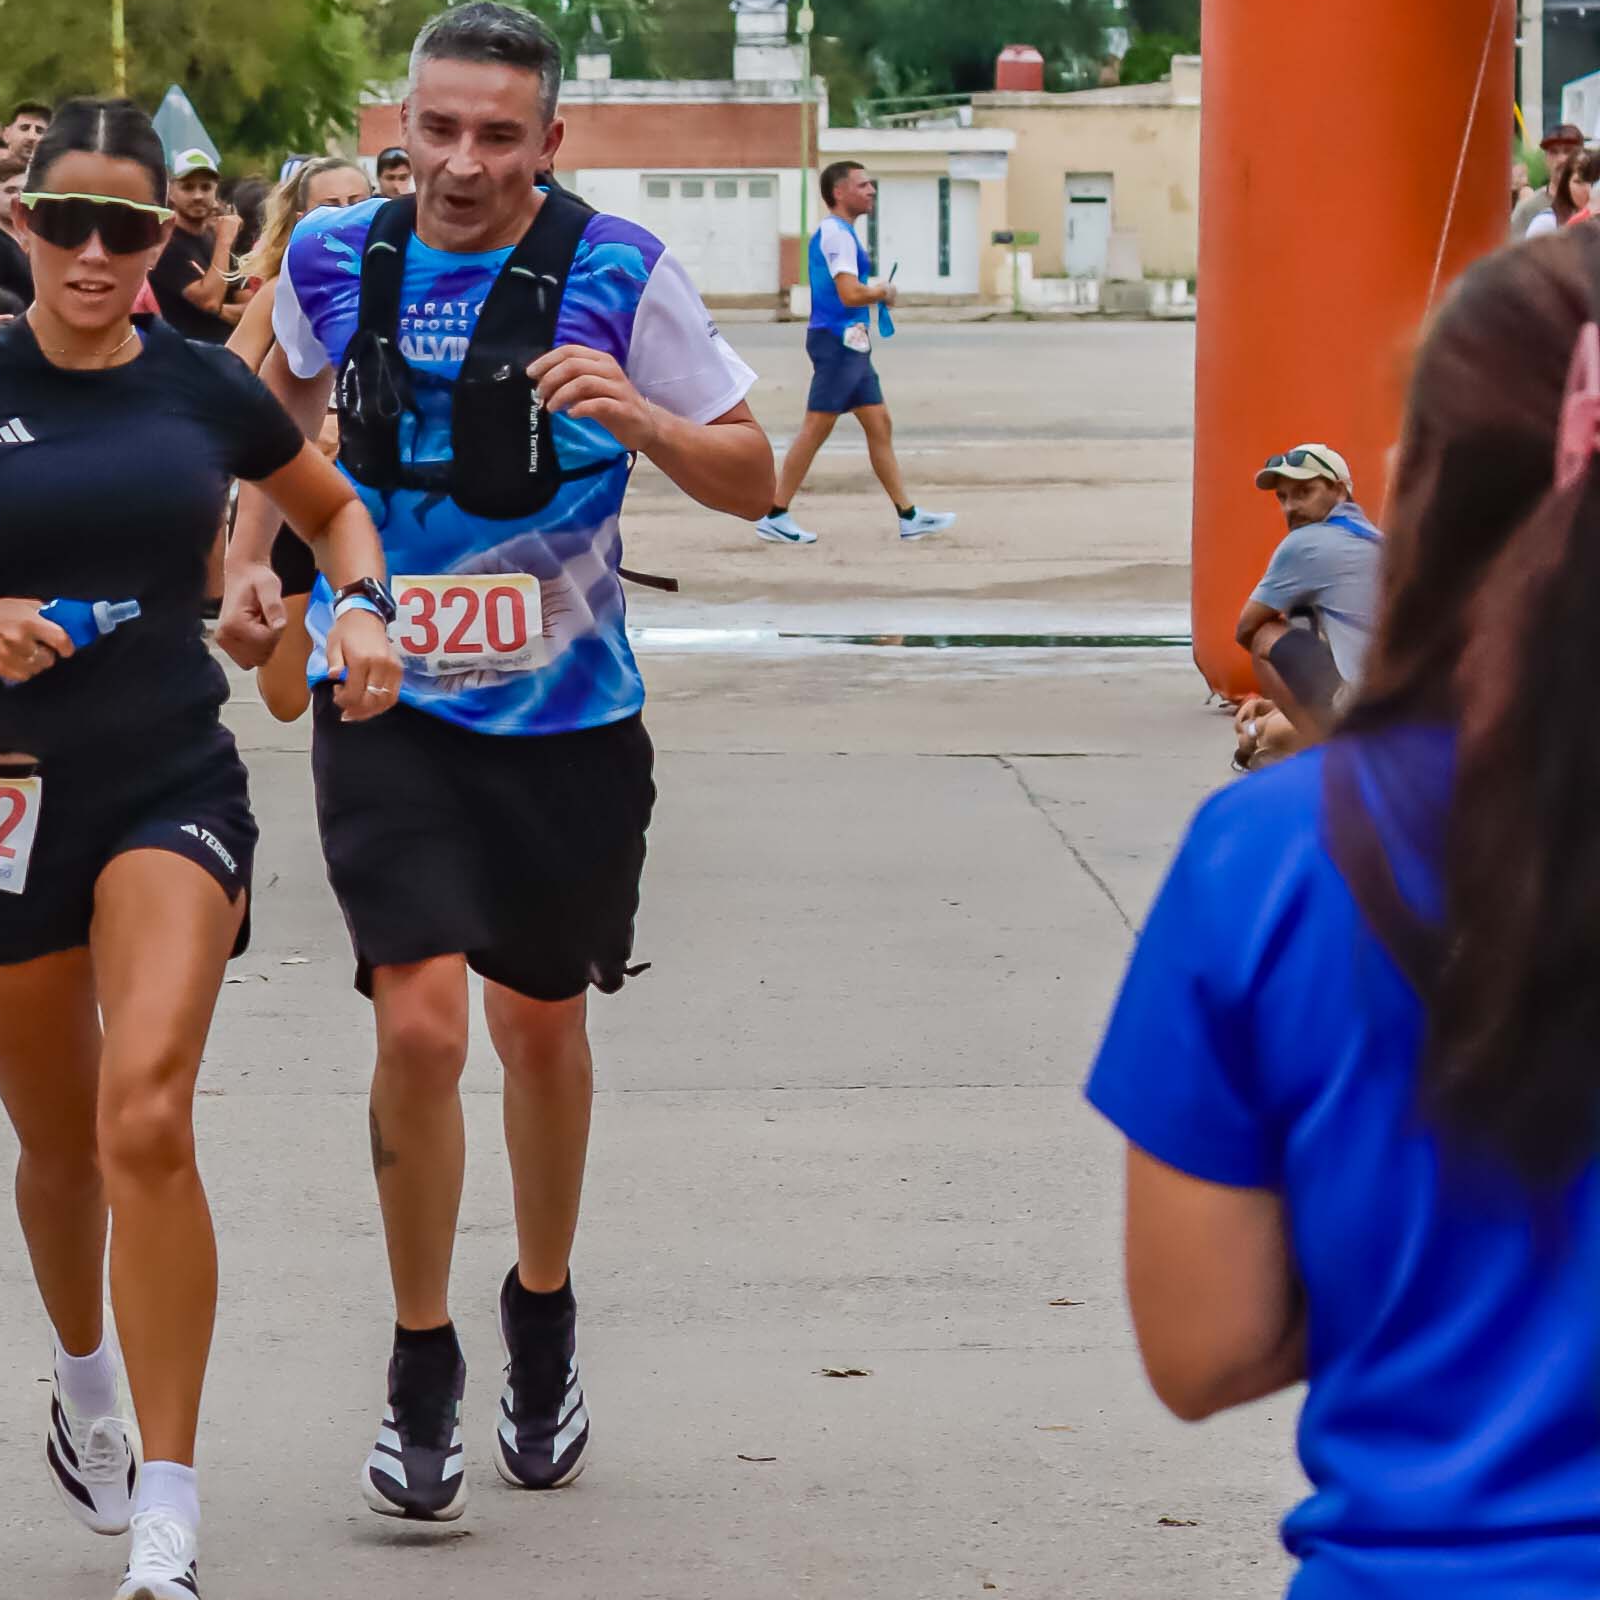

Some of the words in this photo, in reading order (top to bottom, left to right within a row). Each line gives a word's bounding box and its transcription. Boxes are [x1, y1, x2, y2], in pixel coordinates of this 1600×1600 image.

[400, 319, 468, 331] EROES
[399, 586, 527, 654] 320
[201, 828, 238, 873] TERREX
